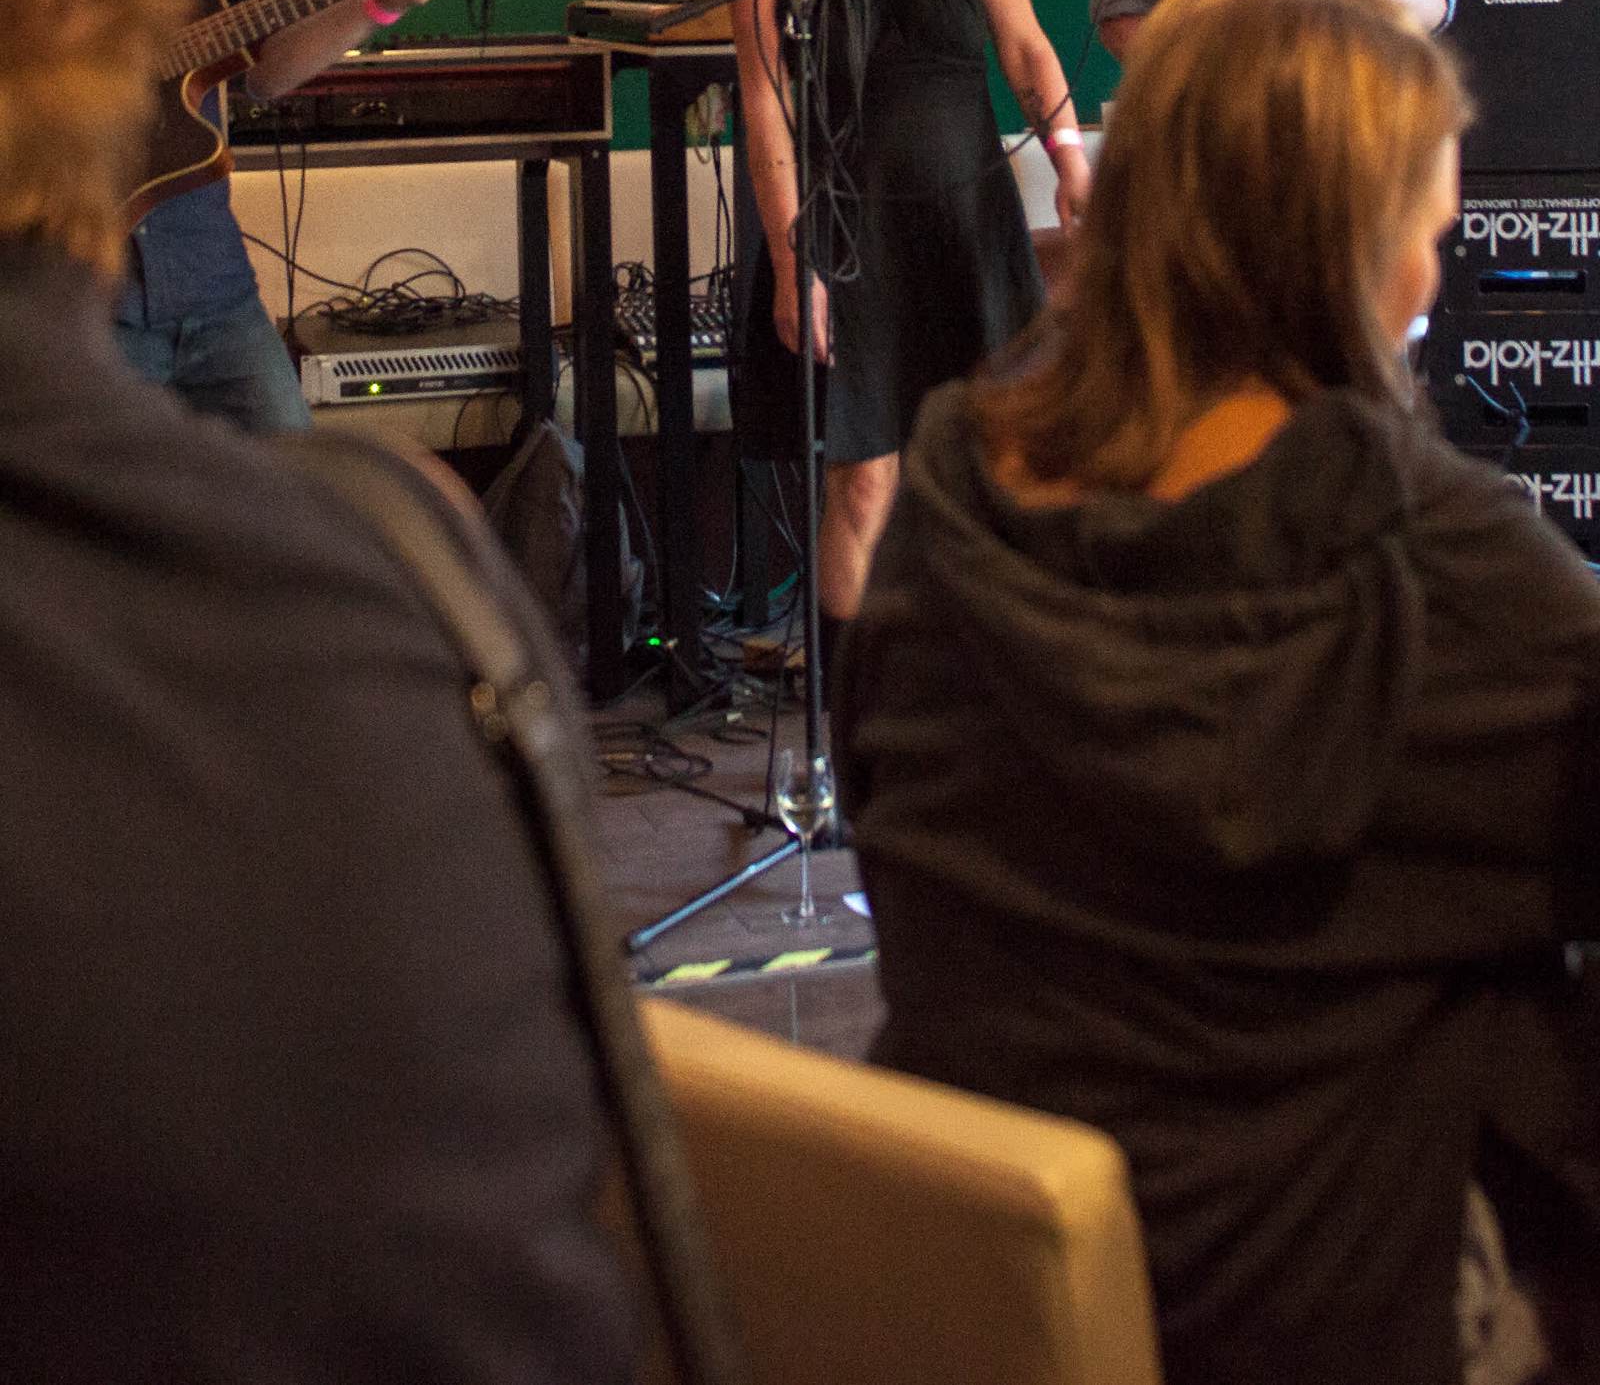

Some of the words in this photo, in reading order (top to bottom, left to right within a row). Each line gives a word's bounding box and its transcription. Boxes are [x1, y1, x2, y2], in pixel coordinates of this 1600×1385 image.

[1463, 198, 1518, 209] LIMONADE
[1520, 198, 1600, 209] OFFEINHALTIGE
[1463, 212, 1600, 256] ritz-kola
[1463, 340, 1600, 386] ritz-kola
